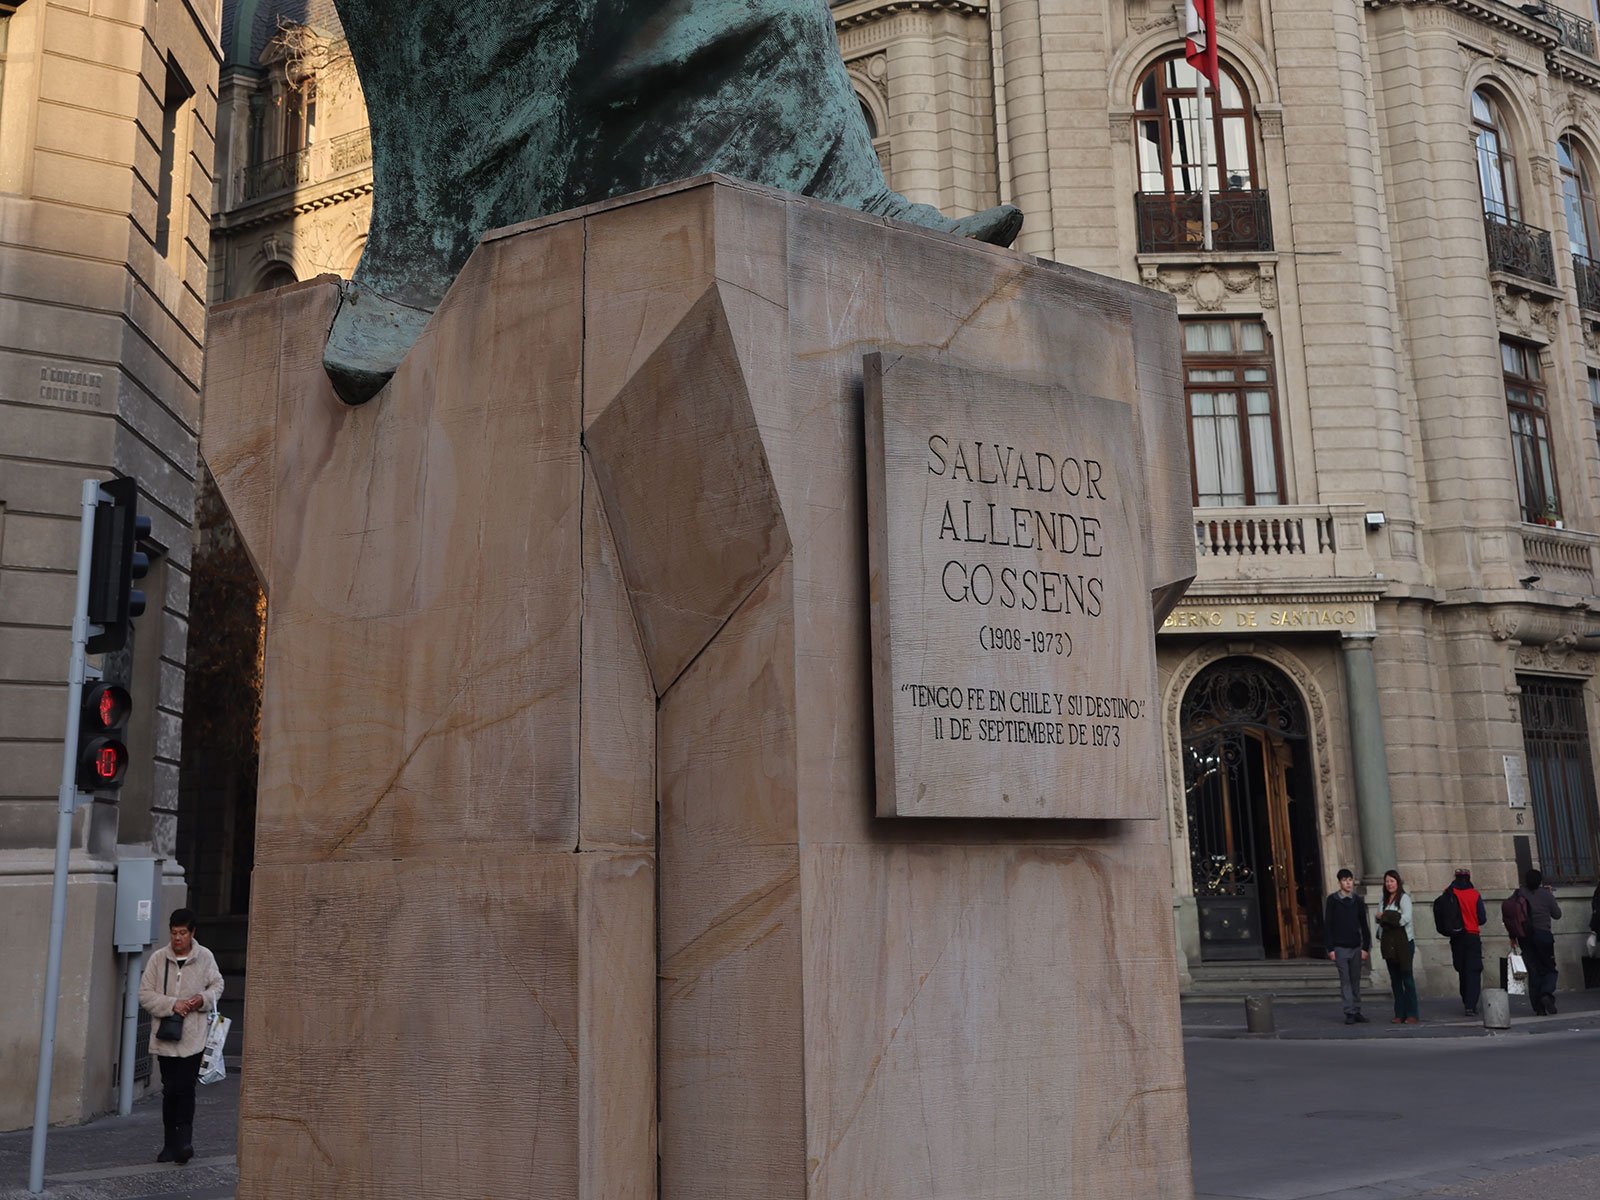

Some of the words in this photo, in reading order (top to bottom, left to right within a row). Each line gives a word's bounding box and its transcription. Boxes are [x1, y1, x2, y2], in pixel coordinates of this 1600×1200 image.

[927, 434, 1107, 501] SALVADOR
[938, 499, 1103, 558] ALLENDE
[941, 559, 1104, 618] GOSSENS
[1236, 611, 1258, 628] DE
[1270, 610, 1356, 627] SANTIAGO
[979, 625, 1073, 658] (1908-1973)
[967, 688, 985, 711] FE
[989, 689, 1006, 712] EN
[1009, 691, 1052, 715] CHILE
[1053, 694, 1064, 716] Y
[1067, 695, 1084, 717] SU
[949, 718, 973, 742] DE
[978, 718, 1065, 745] SEPTIEMBRE
[1068, 723, 1089, 746] DE
[1091, 725, 1121, 748] 1973
